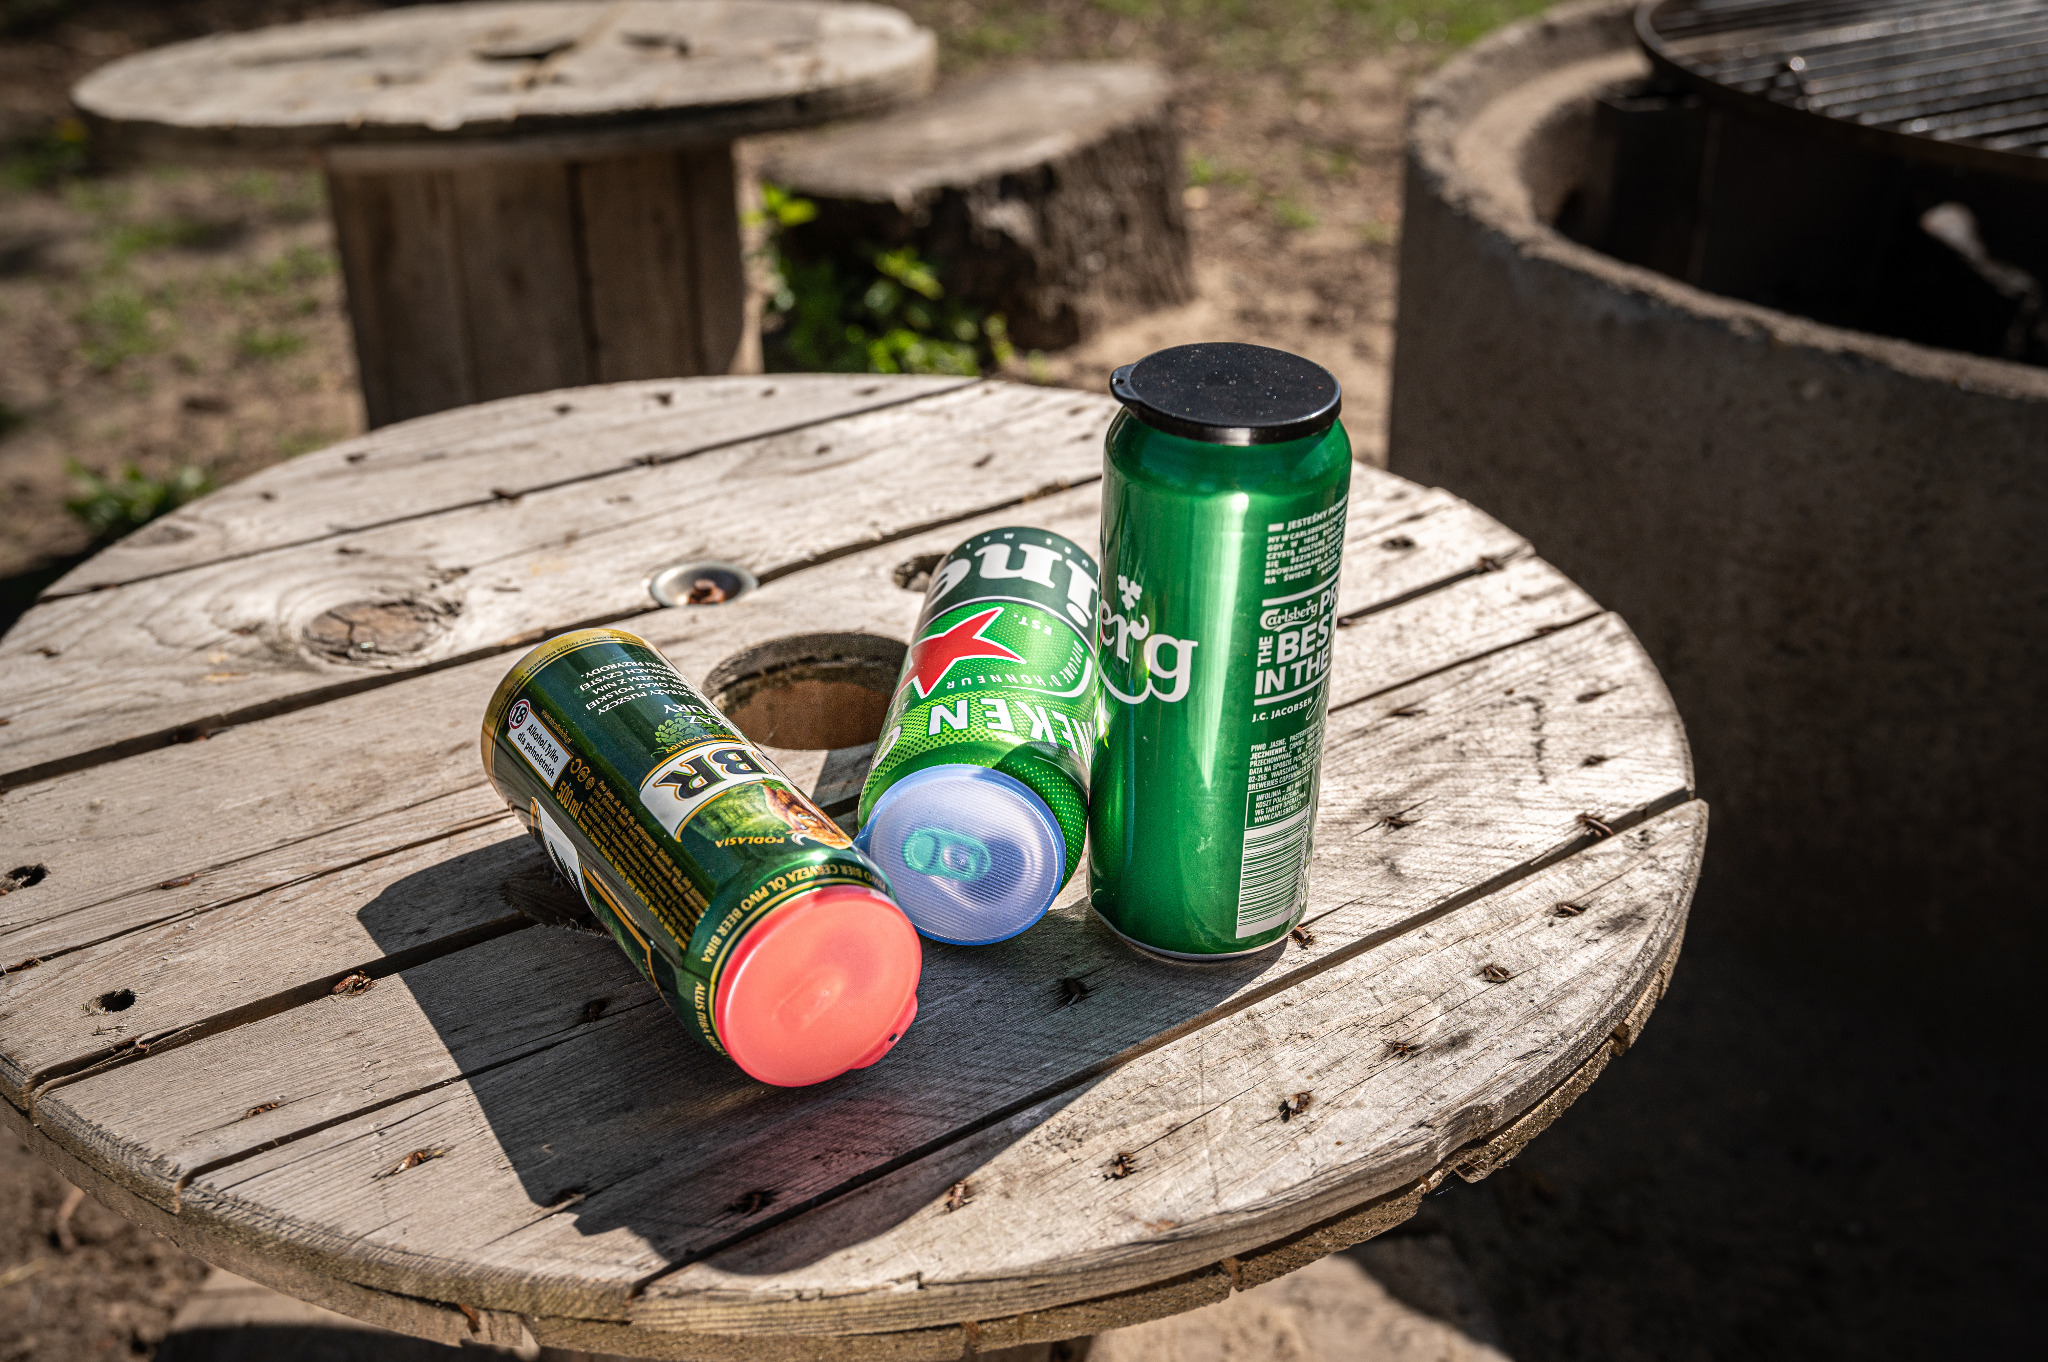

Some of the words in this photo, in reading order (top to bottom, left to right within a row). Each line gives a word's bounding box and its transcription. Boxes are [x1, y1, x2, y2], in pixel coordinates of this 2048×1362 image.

[1013, 613, 1053, 636] EST.
[1260, 600, 1319, 632] Carlsberg
[1100, 600, 1198, 704] erg
[1257, 636, 1273, 667] THE
[579, 671, 624, 691] CZYSTEJ
[1255, 666, 1286, 696] IN
[1290, 643, 1329, 686] THE
[585, 685, 635, 711] POLSKIEJ
[592, 681, 618, 695] NIM
[511, 705, 527, 724] 18
[598, 691, 648, 715] PUSZCZY
[1252, 712, 1269, 723] J.C.
[1271, 696, 1313, 719] JACOBSEN
[517, 732, 525, 745] dla
[556, 780, 573, 809] 500
[714, 835, 785, 850] PODLASIA
[786, 864, 839, 883] CERVEZA
[740, 886, 770, 911] PIVO
[716, 907, 743, 936] BEER
[701, 934, 722, 963] BIRA
[694, 981, 706, 1011] ALUS
